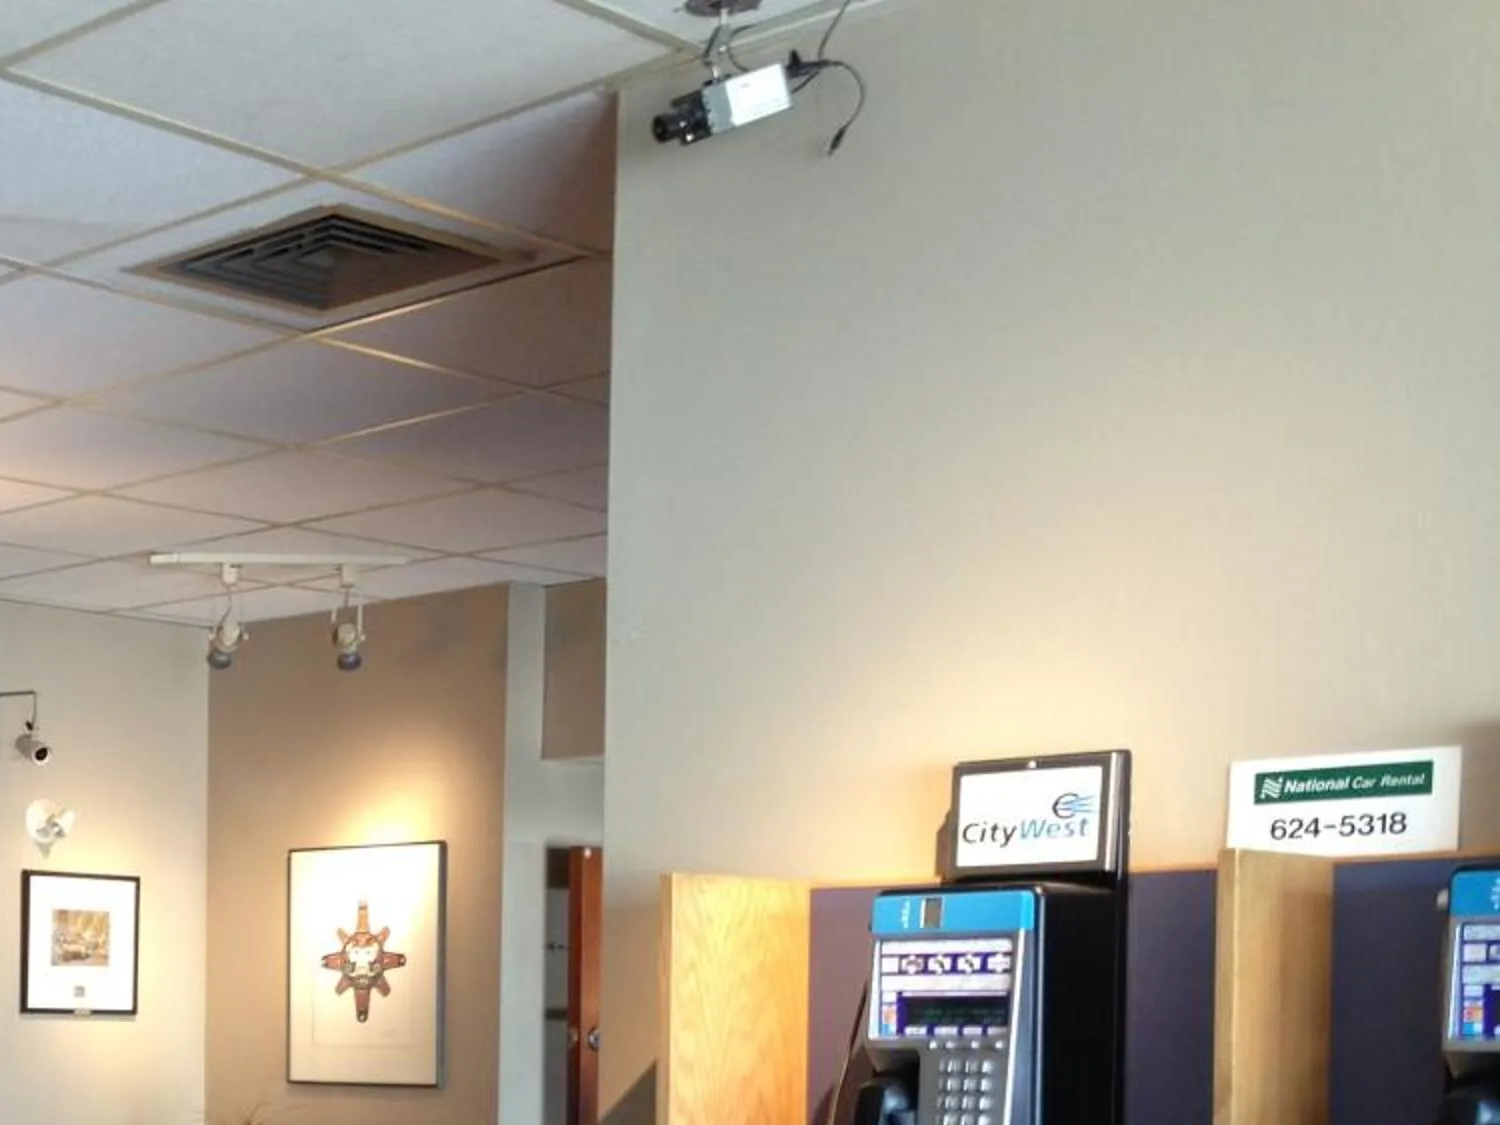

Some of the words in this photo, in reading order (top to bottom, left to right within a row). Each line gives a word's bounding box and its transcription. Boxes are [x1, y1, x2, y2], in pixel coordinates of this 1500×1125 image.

[1283, 777, 1350, 793] National
[1351, 776, 1378, 789] Car
[1379, 772, 1426, 787] Rental
[1270, 811, 1408, 840] 624-5318
